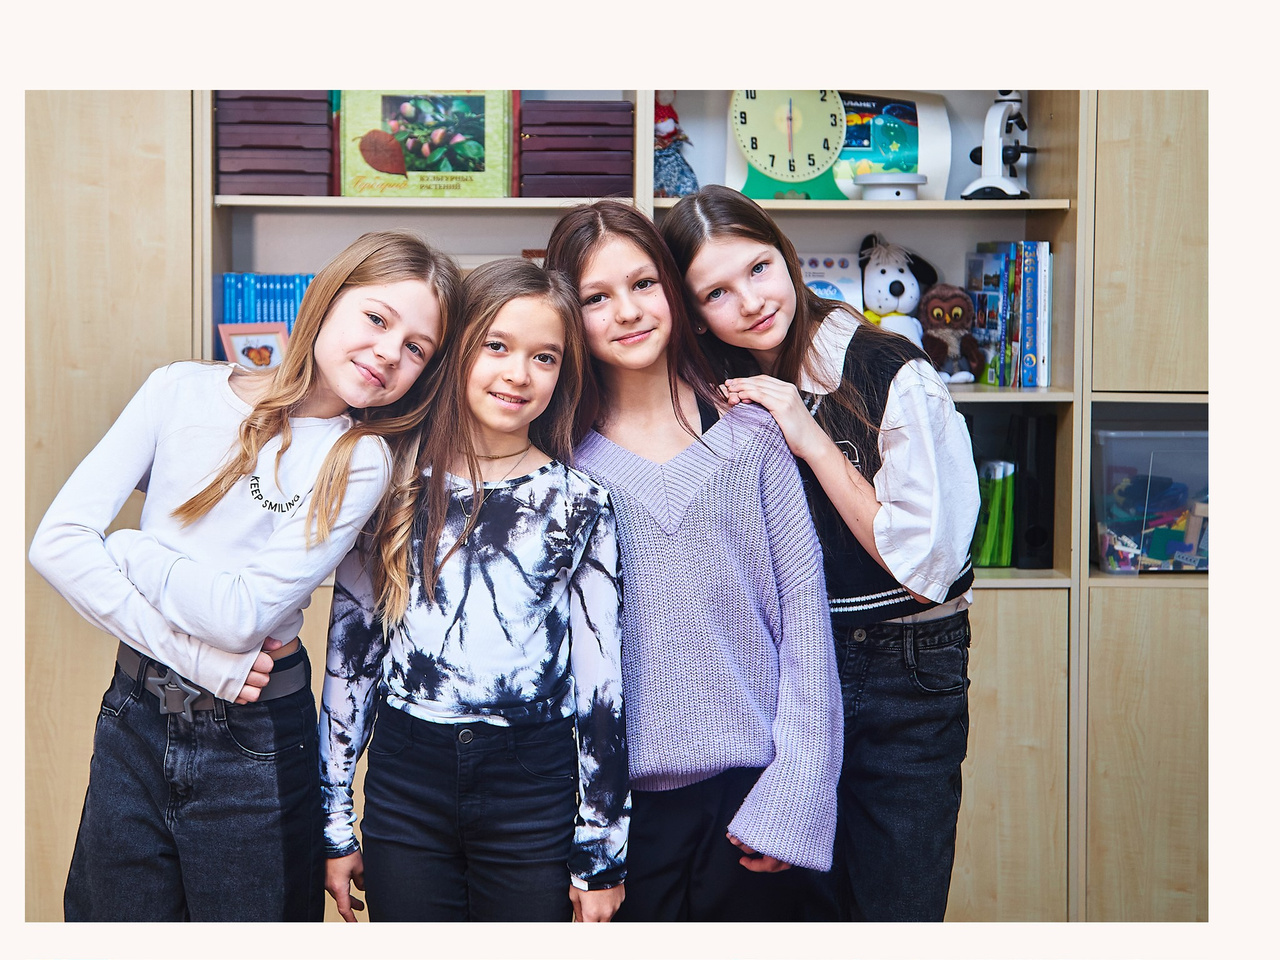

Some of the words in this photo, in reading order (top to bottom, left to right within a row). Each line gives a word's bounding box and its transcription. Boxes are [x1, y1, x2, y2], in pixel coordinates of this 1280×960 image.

[740, 112, 747, 125] 9
[830, 114, 837, 126] 3
[751, 137, 758, 150] 8
[823, 138, 830, 150] 4
[769, 154, 776, 167] 7
[789, 159, 795, 172] 6
[808, 154, 815, 166] 5
[1024, 251, 1035, 273] 365
[250, 476, 263, 500] KEEP
[262, 494, 300, 512] SMILING
